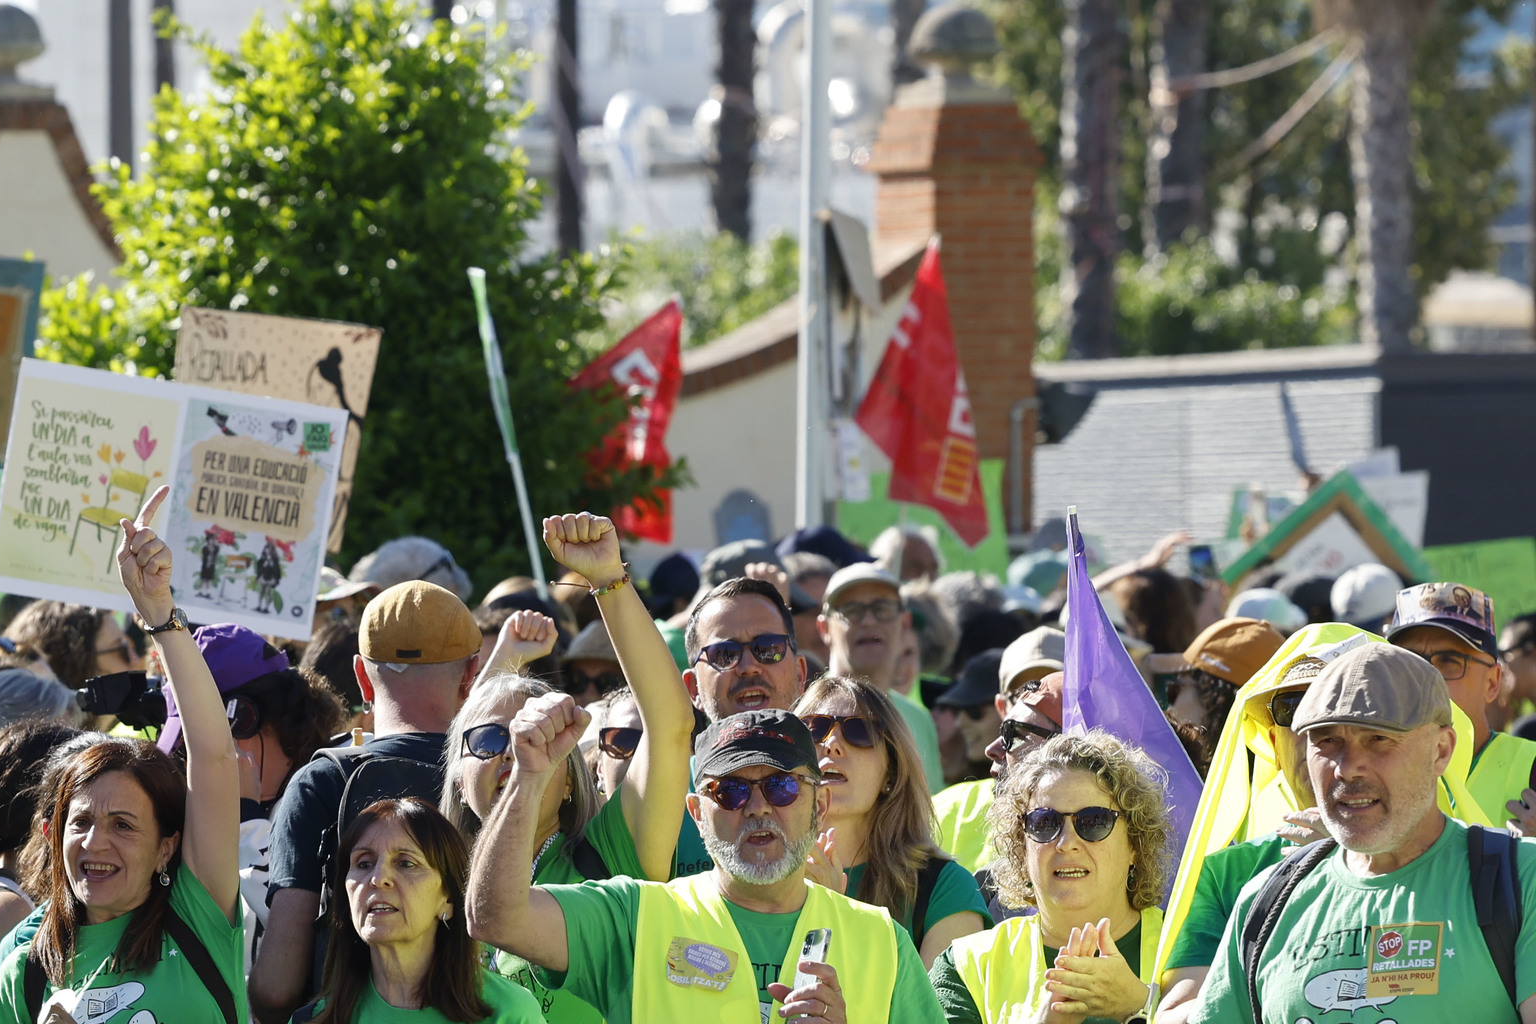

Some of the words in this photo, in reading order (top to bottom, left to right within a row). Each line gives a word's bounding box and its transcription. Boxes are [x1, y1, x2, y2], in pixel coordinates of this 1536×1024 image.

[32, 422, 50, 441] UN
[54, 425, 77, 446] DIA
[81, 434, 93, 449] a
[203, 451, 226, 471] PER
[228, 454, 250, 475] UNA
[253, 459, 308, 484] EDUCACIÓ
[23, 495, 43, 515] UN
[47, 497, 71, 520] DIA
[196, 486, 220, 516] EN
[225, 489, 301, 528] VALENCIÀ
[13, 513, 32, 530] de
[35, 521, 68, 542] vaga
[677, 858, 714, 874] Defe
[1378, 937, 1402, 953] STOP
[1407, 940, 1432, 956] FP
[1372, 958, 1435, 972] RETALLADES
[1371, 976, 1380, 984] JA
[1381, 974, 1396, 982] N'HI
[1410, 972, 1435, 981] PROU!
